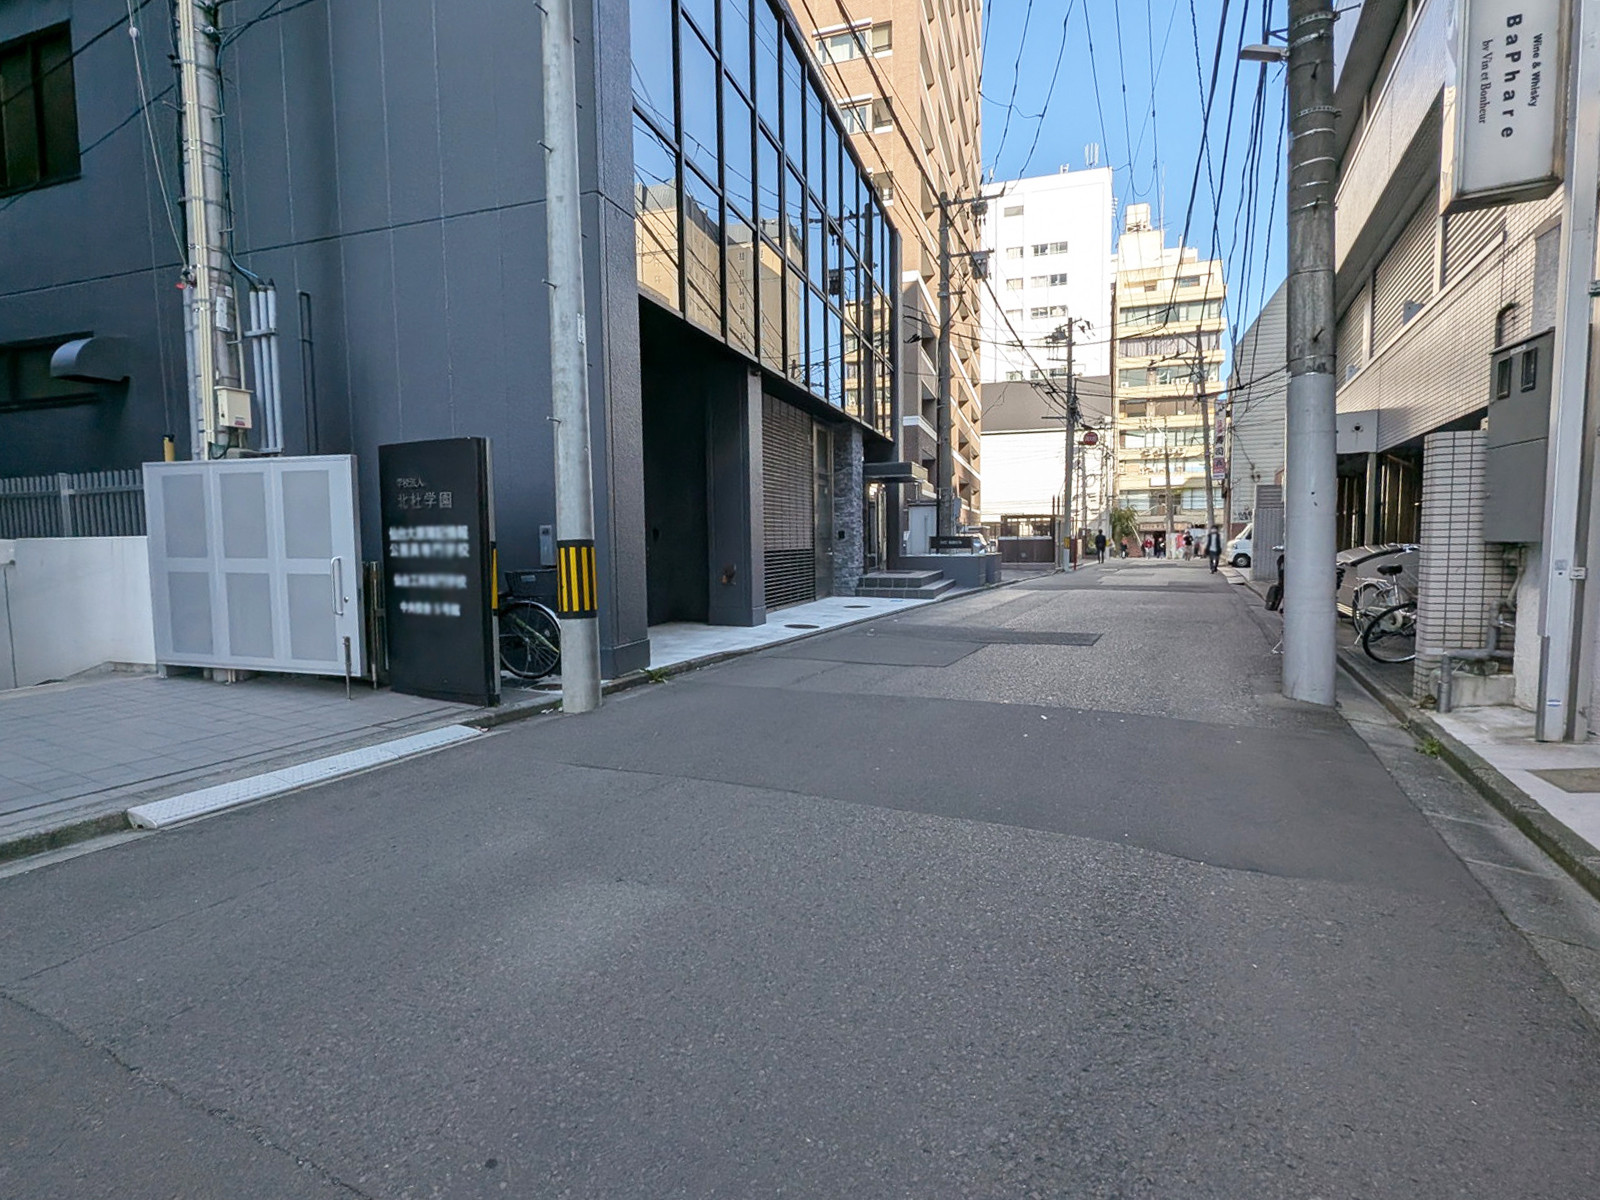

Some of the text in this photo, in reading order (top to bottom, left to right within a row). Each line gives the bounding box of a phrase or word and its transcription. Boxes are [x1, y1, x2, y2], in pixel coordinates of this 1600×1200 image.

[1482, 39, 1494, 51] by
[1532, 33, 1543, 59] Wine
[1481, 52, 1493, 70] Vin
[1528, 71, 1541, 106] Whisky
[1479, 82, 1492, 124] Bonheur
